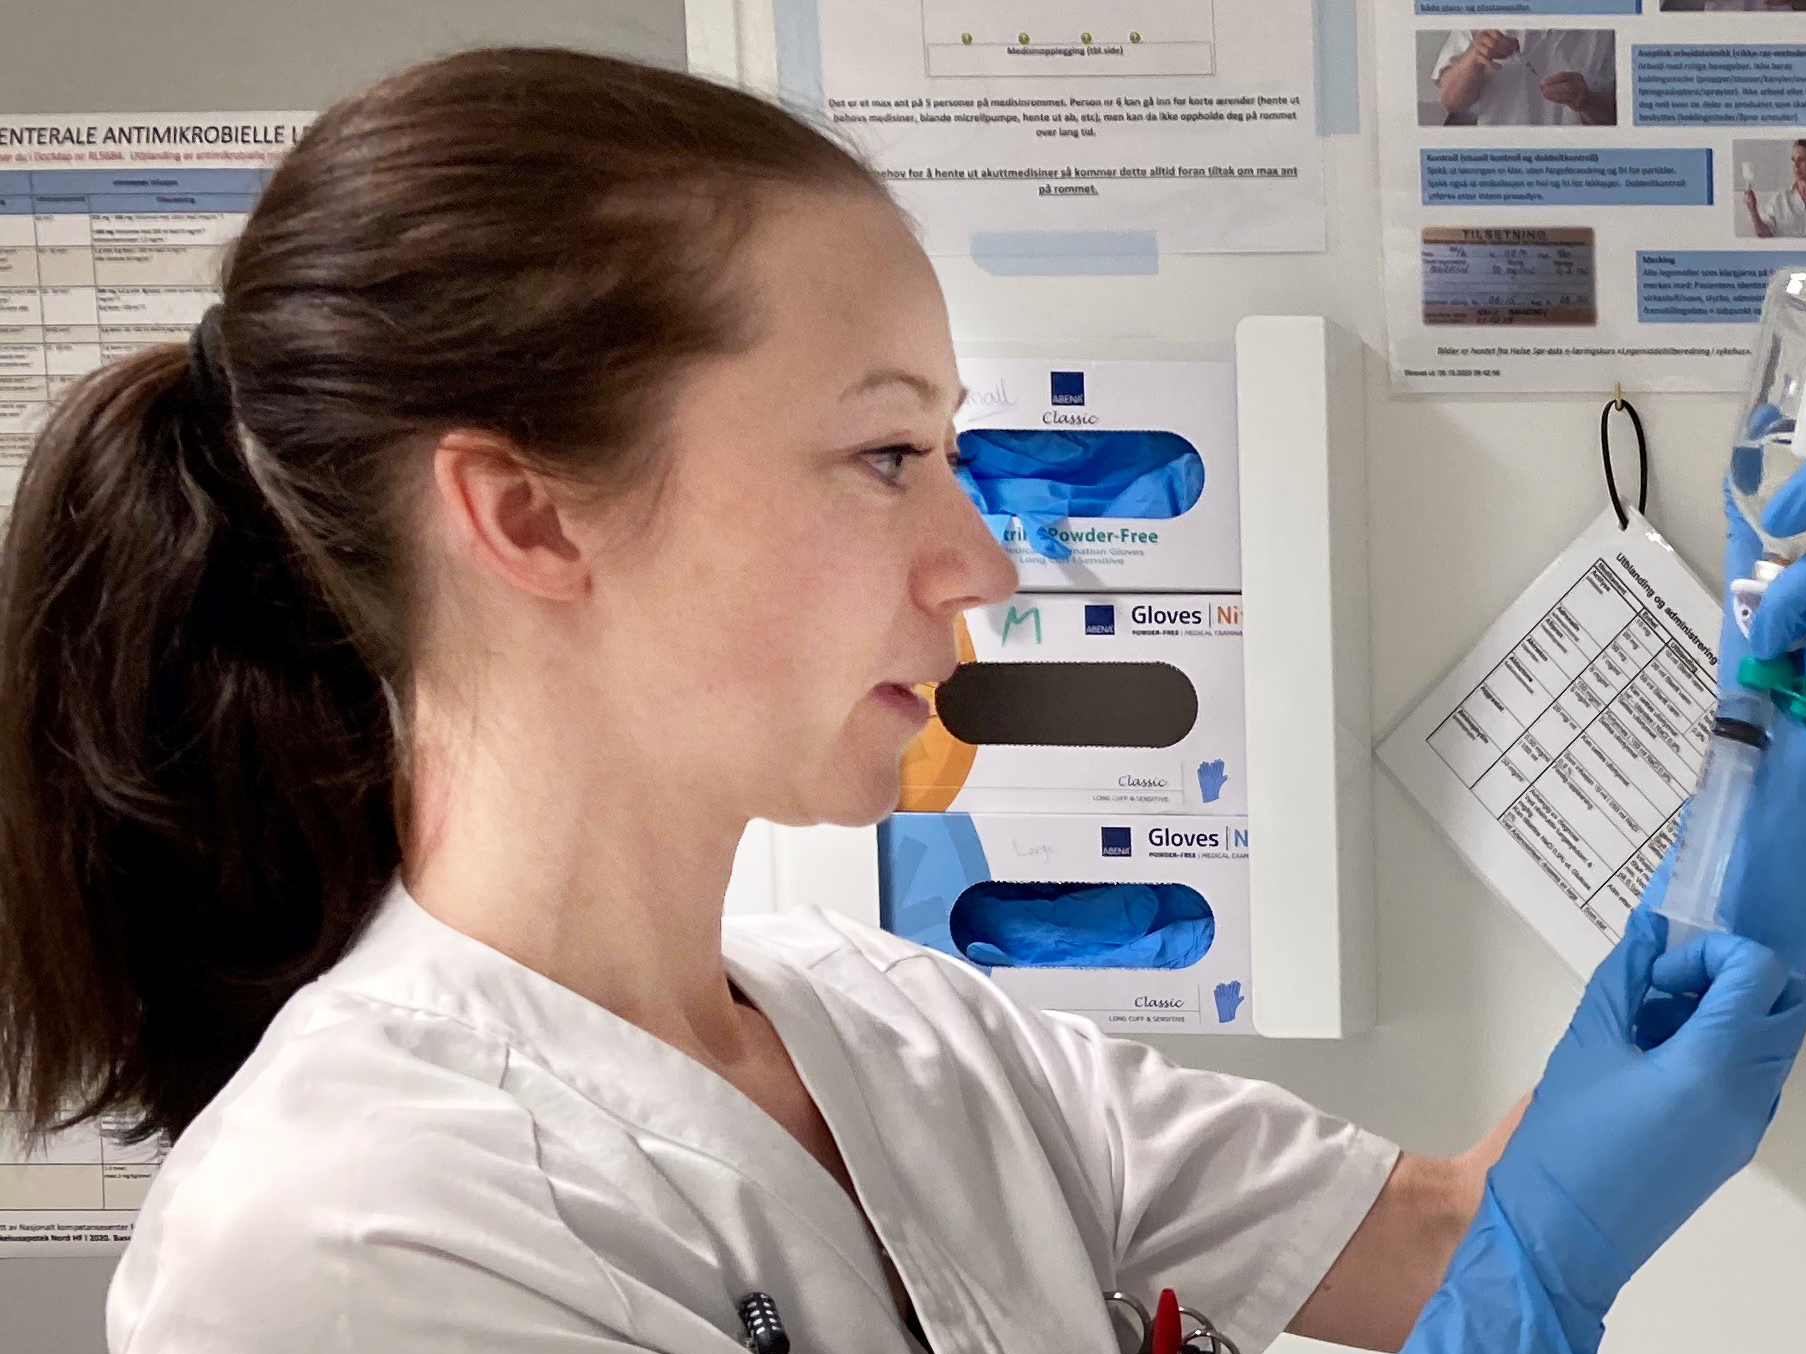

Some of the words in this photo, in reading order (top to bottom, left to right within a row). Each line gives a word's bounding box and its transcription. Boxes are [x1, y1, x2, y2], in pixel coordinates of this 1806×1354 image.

[102, 125, 285, 144] ANTIMIKROBIELLE
[877, 168, 905, 177] ehov
[935, 168, 965, 177] hente
[1052, 394, 1084, 404] ABENA
[1042, 410, 1099, 426] Classic
[1047, 526, 1159, 544] Powder-Free
[1131, 605, 1202, 625] Gloves
[1217, 605, 1243, 625] Ni
[1616, 551, 1655, 598] Utblanding
[1654, 594, 1666, 610] og
[1664, 607, 1718, 666] administrering
[1002, 605, 1043, 647] M
[1086, 624, 1114, 634] ABENA
[1118, 774, 1168, 788] Classic
[1148, 827, 1219, 847] Gloves
[1102, 846, 1131, 856] ABENA
[1134, 996, 1185, 1008] Classic
